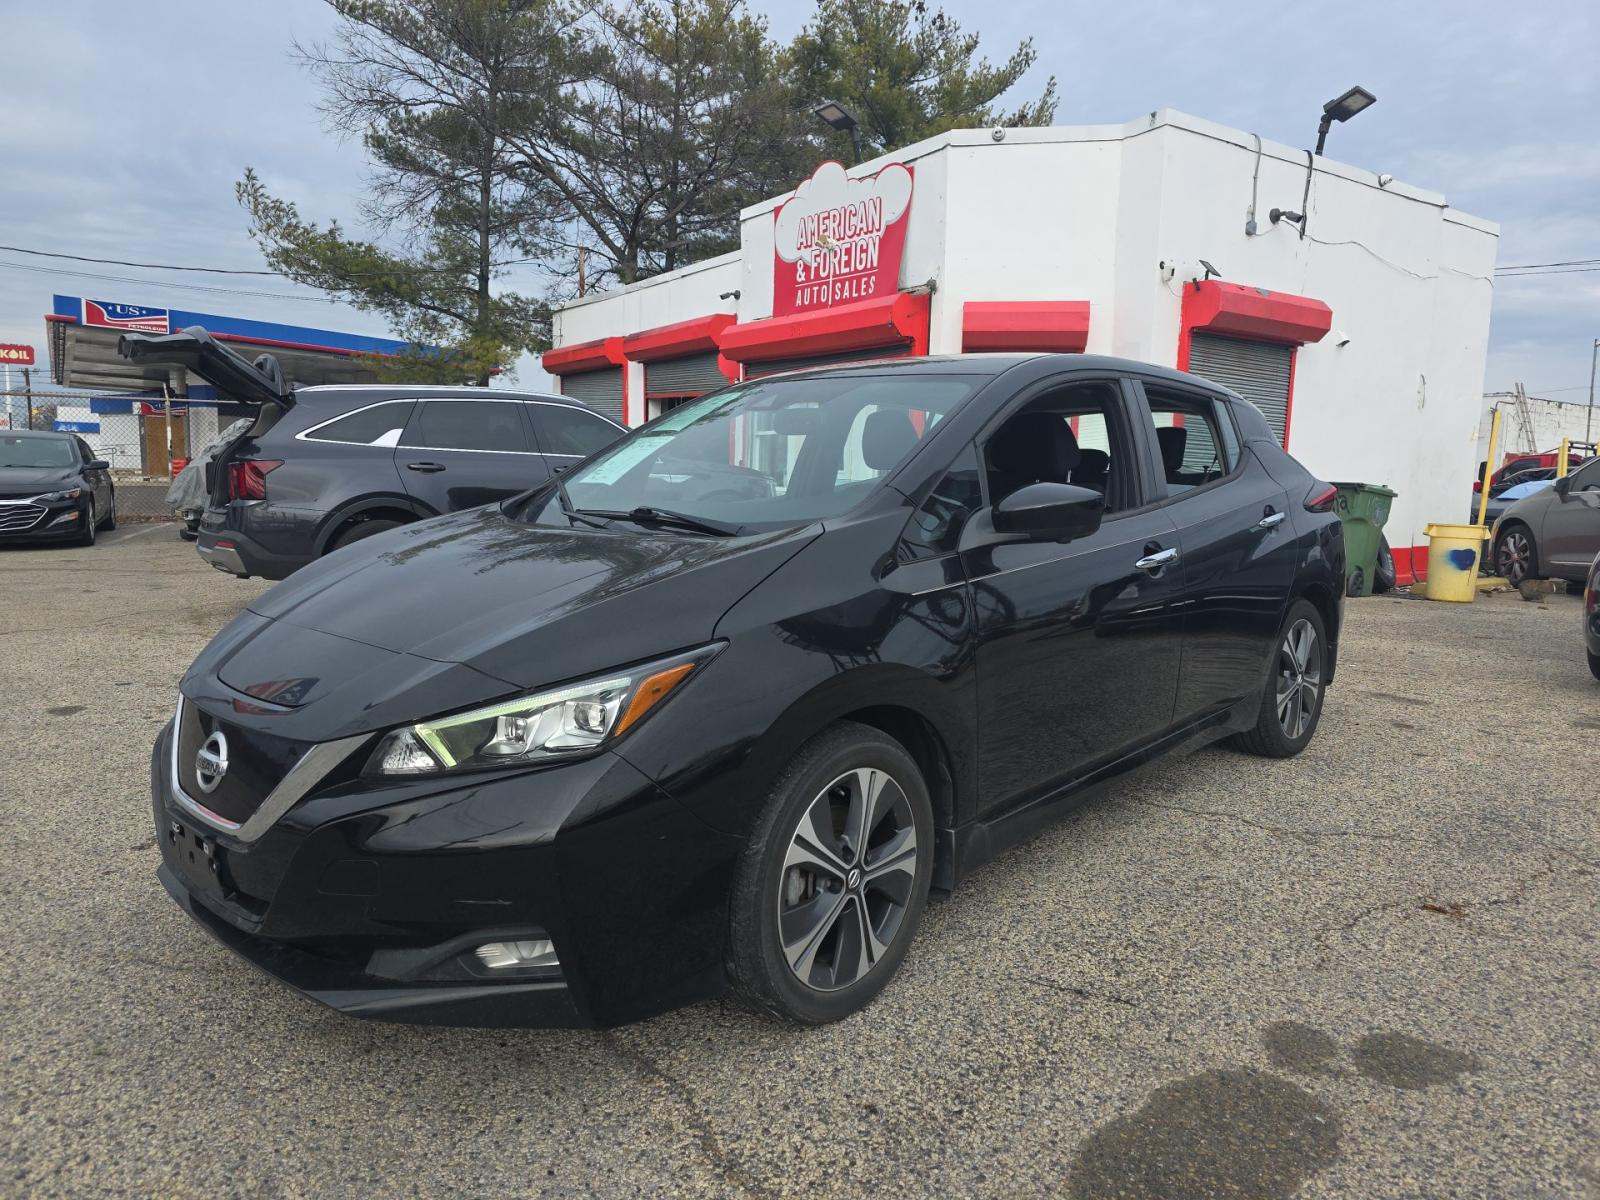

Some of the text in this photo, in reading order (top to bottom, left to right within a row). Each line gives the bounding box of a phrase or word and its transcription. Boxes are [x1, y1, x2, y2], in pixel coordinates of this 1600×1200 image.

[797, 196, 882, 250] AMERICAN
[796, 234, 881, 282] & FOREIGN
[115, 305, 140, 315] US
[795, 275, 876, 307] AUTO SALES
